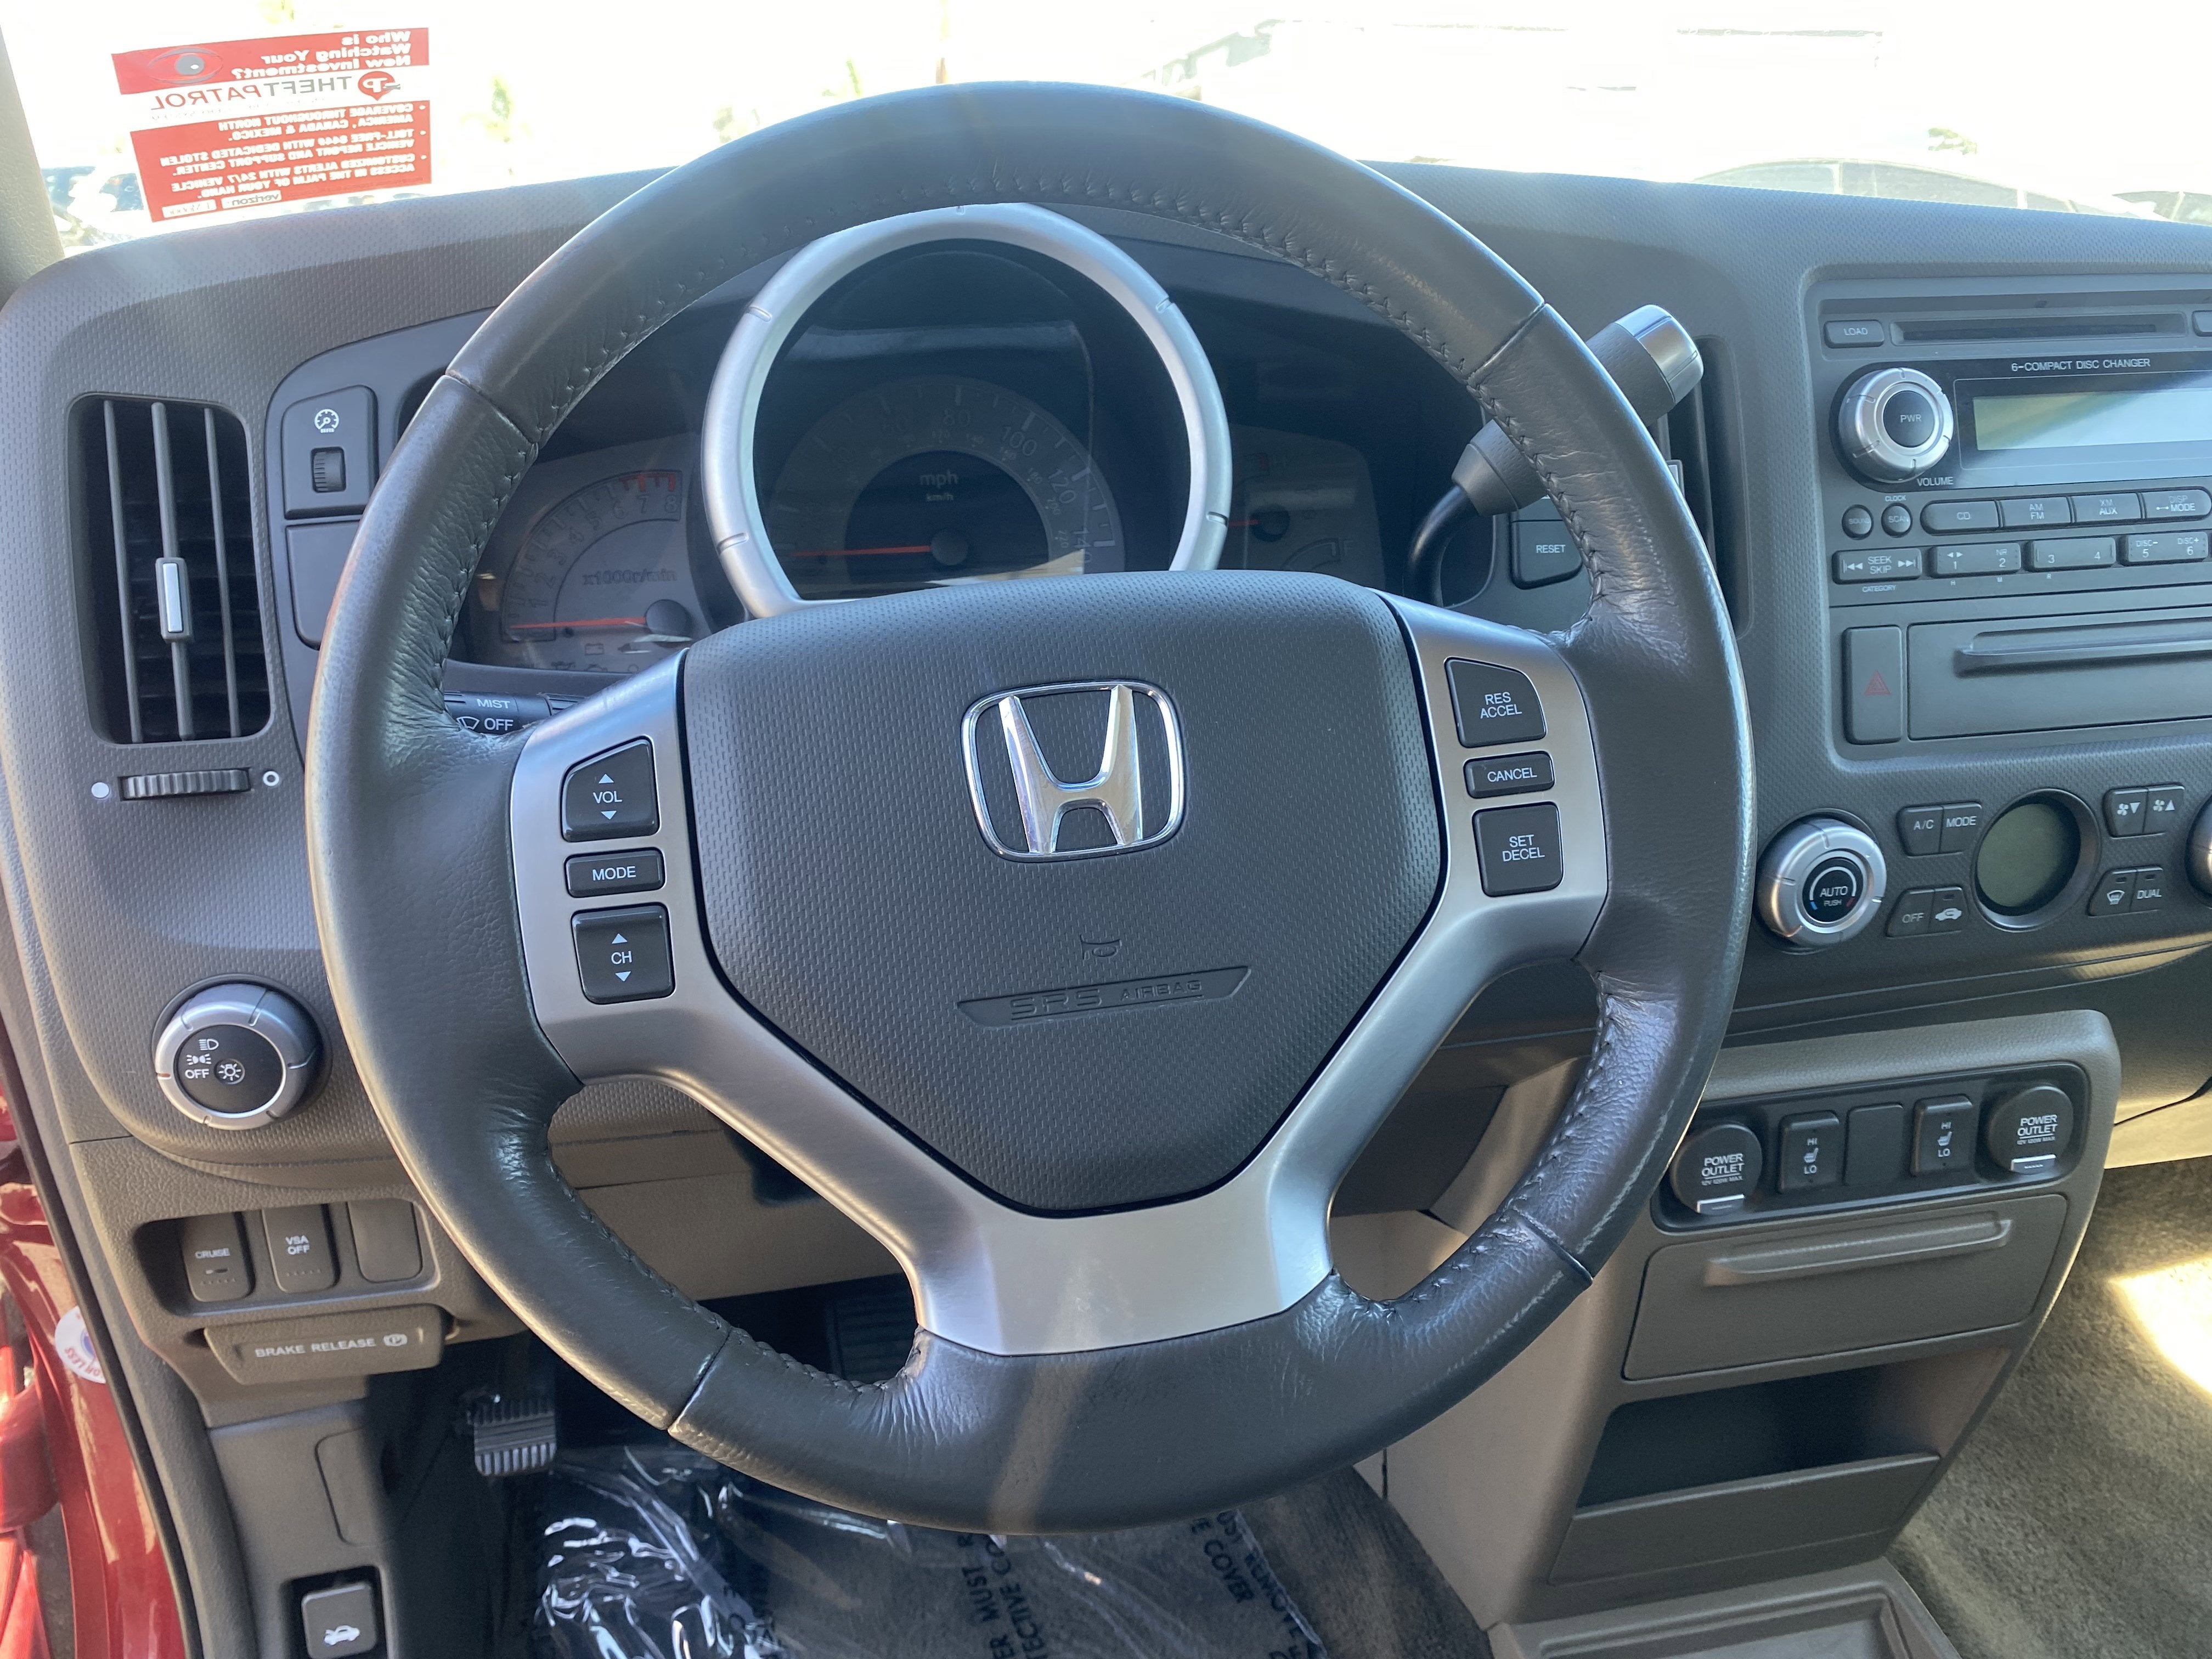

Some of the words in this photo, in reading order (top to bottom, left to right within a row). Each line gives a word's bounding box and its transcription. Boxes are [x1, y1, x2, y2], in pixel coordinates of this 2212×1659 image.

[1843, 328, 1868, 336] LOAD
[2011, 360, 2073, 372] 6-COMPACT
[2076, 359, 2100, 370] DISC
[2103, 358, 2151, 369] CHANGER
[1900, 414, 1922, 423] PWR
[1000, 425, 1039, 457] 100
[918, 470, 960, 489] mph
[1917, 476, 1954, 486] VOLUME
[1048, 468, 1078, 504] 120
[925, 491, 955, 503] km/h
[2169, 495, 2188, 504] DISP
[2099, 507, 2118, 515] AUX
[2171, 503, 2196, 512] MODE
[1956, 512, 1972, 520] CD
[2031, 512, 2045, 520] FM
[1536, 544, 1566, 554] RESET
[2142, 549, 2149, 558] 5
[2187, 546, 2194, 555] 6
[1868, 556, 1892, 565] SEEK
[2047, 554, 2055, 563] 3
[2094, 551, 2101, 561] 4
[1953, 561, 1957, 569] 1
[1999, 558, 2006, 567] 2
[1870, 565, 1892, 574] SKIP
[1862, 584, 1897, 592] CATEGORY
[476, 698, 511, 708] MIST
[1484, 691, 1511, 705] RES
[1480, 703, 1522, 719] ACCEL
[484, 718, 514, 731] OFF
[1487, 768, 1537, 782] CANCEL
[592, 790, 623, 804] VOL
[1913, 820, 1934, 831] A/C
[1946, 816, 1977, 828] MODE
[1509, 834, 1534, 848] SET
[1503, 847, 1545, 862] DECEL
[592, 866, 636, 881] MODE
[1820, 886, 1848, 898] AUTO
[2137, 889, 2162, 900] DUAL
[1824, 899, 1842, 907] PUSH
[1902, 912, 1925, 924] OFF
[611, 951, 633, 964] CH
[1009, 989, 1103, 1017] SRS
[1120, 980, 1203, 1001] AIRBAG
[185, 1069, 209, 1079] OFF
[2021, 1114, 2057, 1126] POWER
[2017, 1124, 2058, 1137] OUTLET
[1807, 1138, 1818, 1146] HI
[1938, 1148, 1950, 1158] LO
[1704, 1153, 1743, 1167] POWER
[1701, 1163, 1745, 1177] OUTLET
[1804, 1165, 1817, 1175] LO
[285, 1234, 309, 1245] VSA
[195, 1248, 230, 1260] CRUISE
[287, 1244, 310, 1255] OFF
[255, 1345, 306, 1358] BRAKE
[311, 1338, 376, 1353] RELEASE
[1204, 1538, 1255, 1604] COVER
